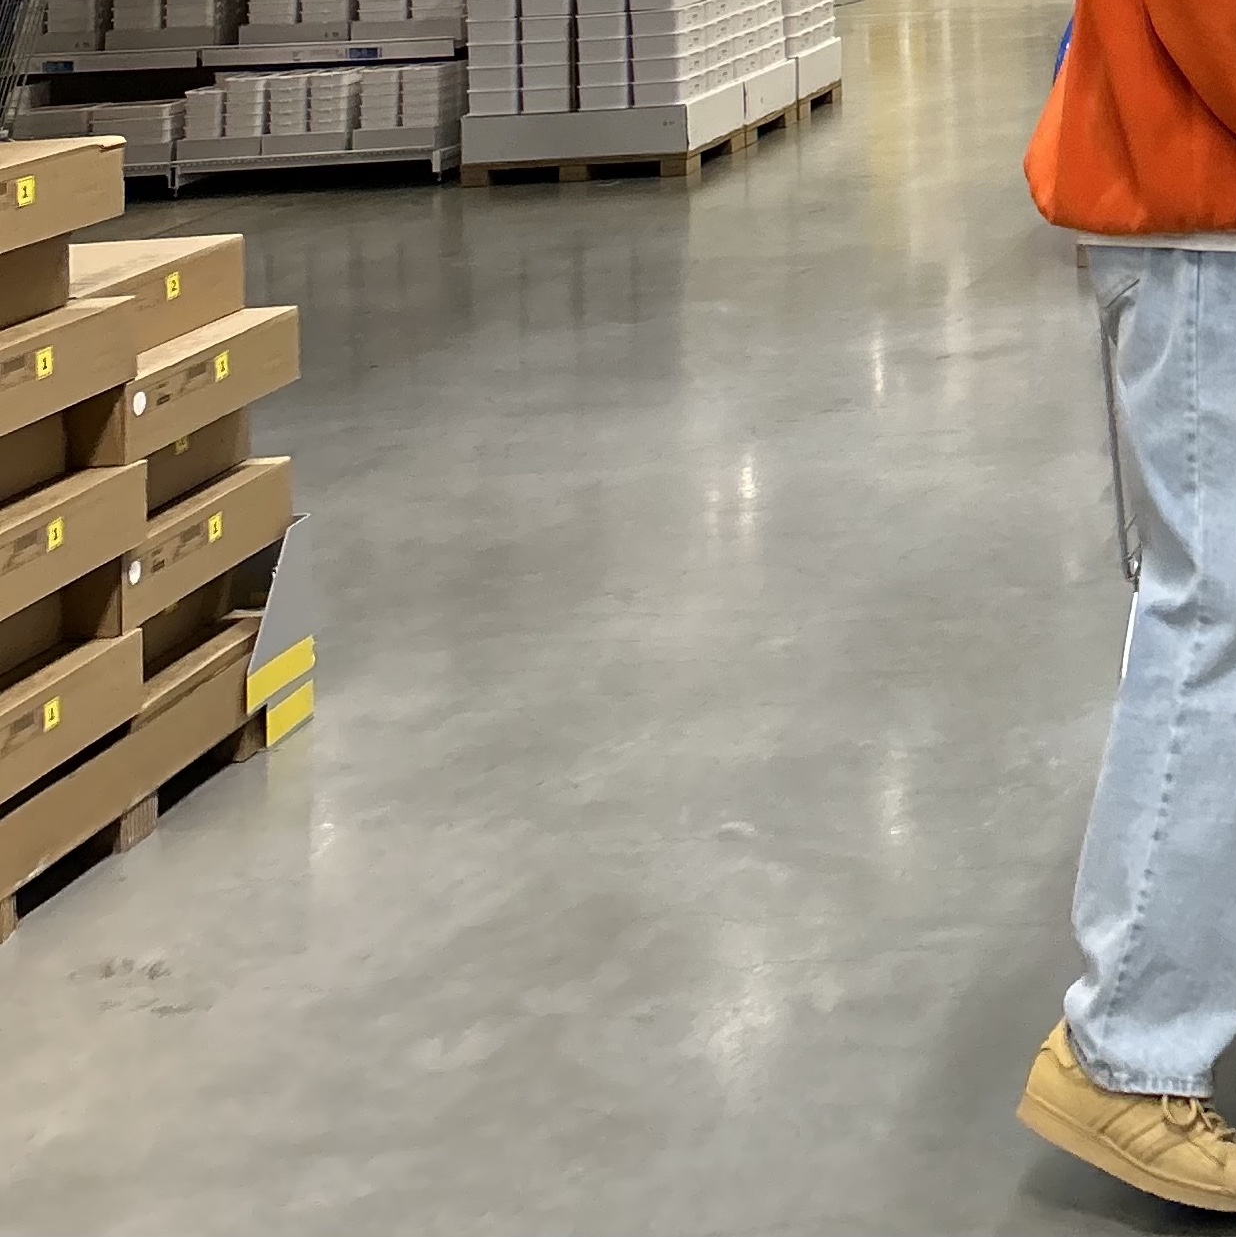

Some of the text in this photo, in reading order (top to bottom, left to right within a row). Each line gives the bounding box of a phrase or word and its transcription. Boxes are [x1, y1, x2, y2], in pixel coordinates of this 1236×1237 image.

[22, 185, 28, 199] 1
[171, 279, 178, 292] 2
[42, 357, 48, 371] 1
[220, 360, 225, 372] 1
[52, 527, 59, 541] 1
[212, 521, 219, 535] 1
[48, 707, 55, 722] 1
